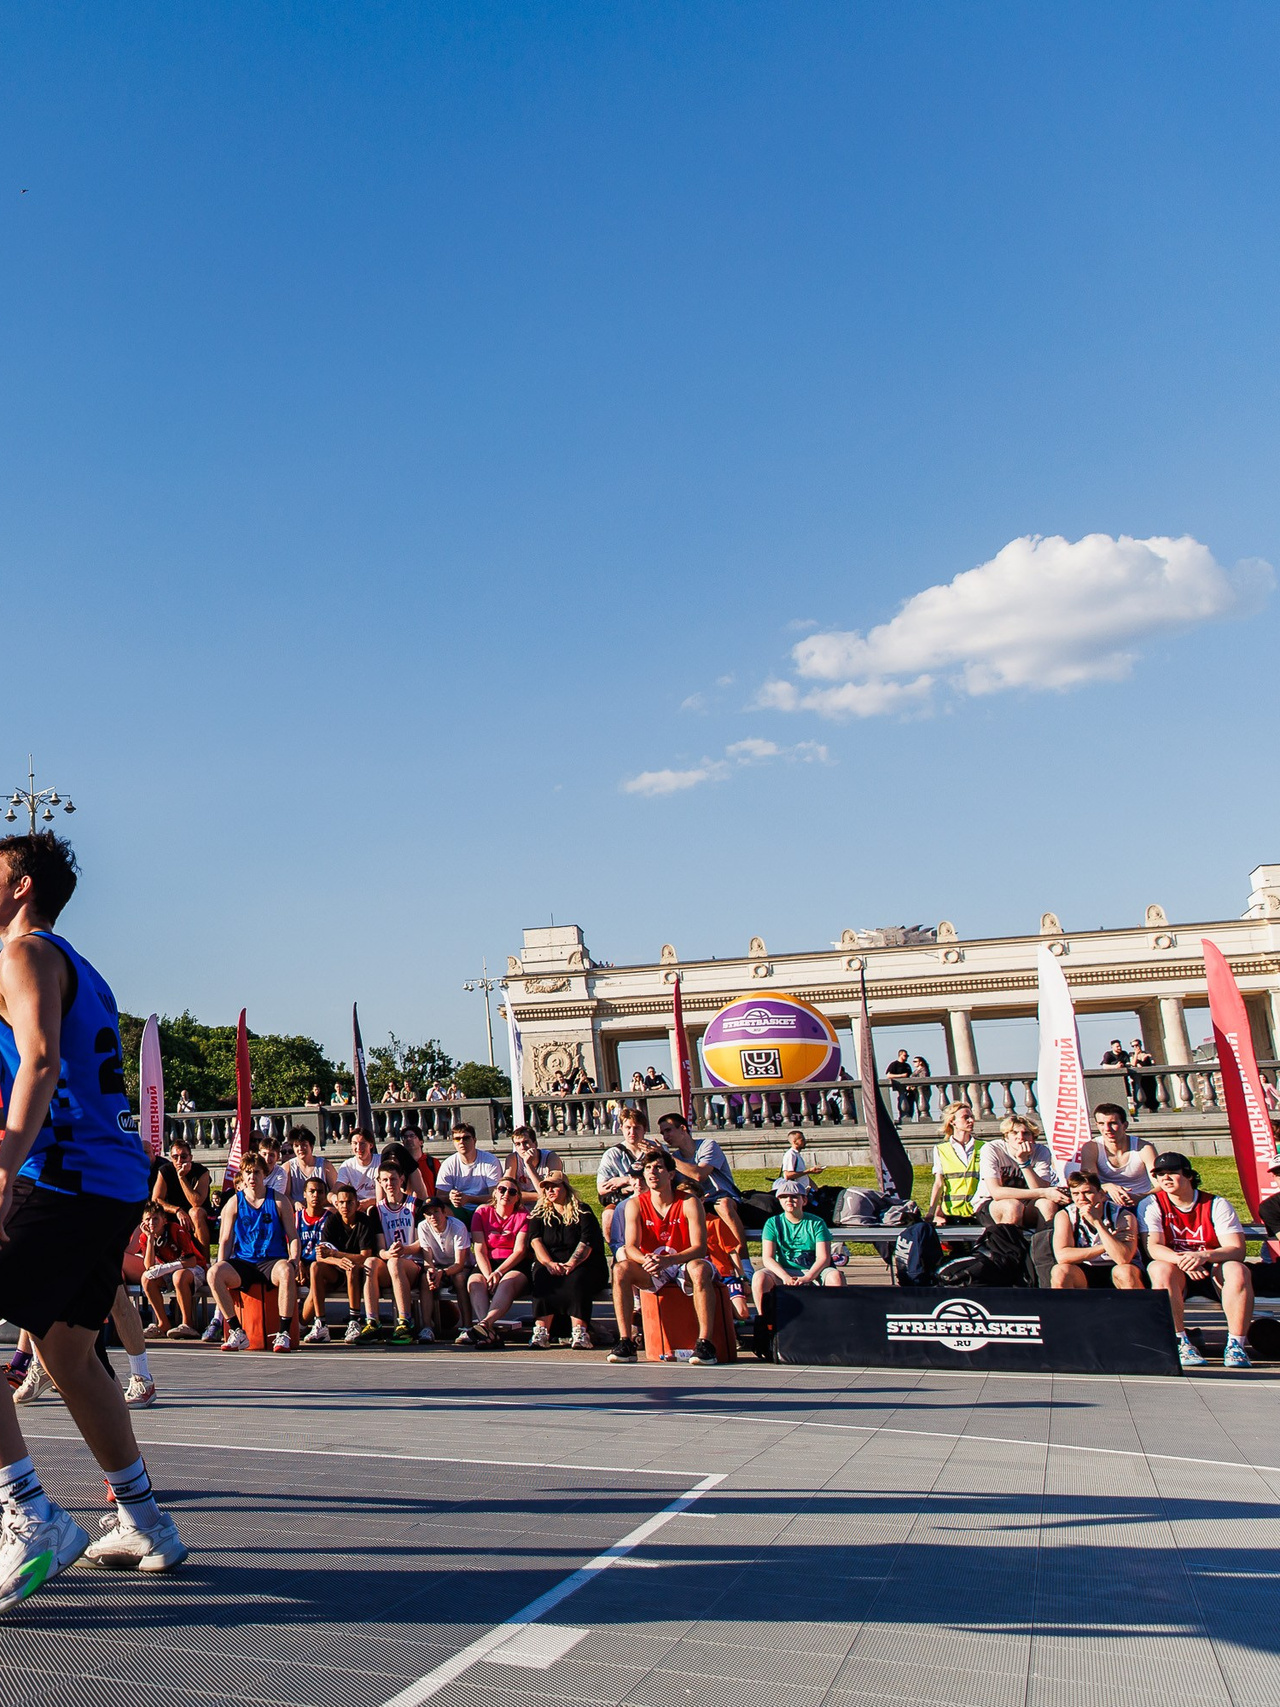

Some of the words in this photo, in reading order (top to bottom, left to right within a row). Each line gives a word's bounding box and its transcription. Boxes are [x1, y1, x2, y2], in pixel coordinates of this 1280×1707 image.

[722, 1018, 796, 1029] STREETBASKET
[146, 1086, 161, 1156] КОВСКИЙ
[1052, 1038, 1078, 1162] МОСКОВСКИЙ
[886, 1321, 1042, 1336] STREETBASKET
